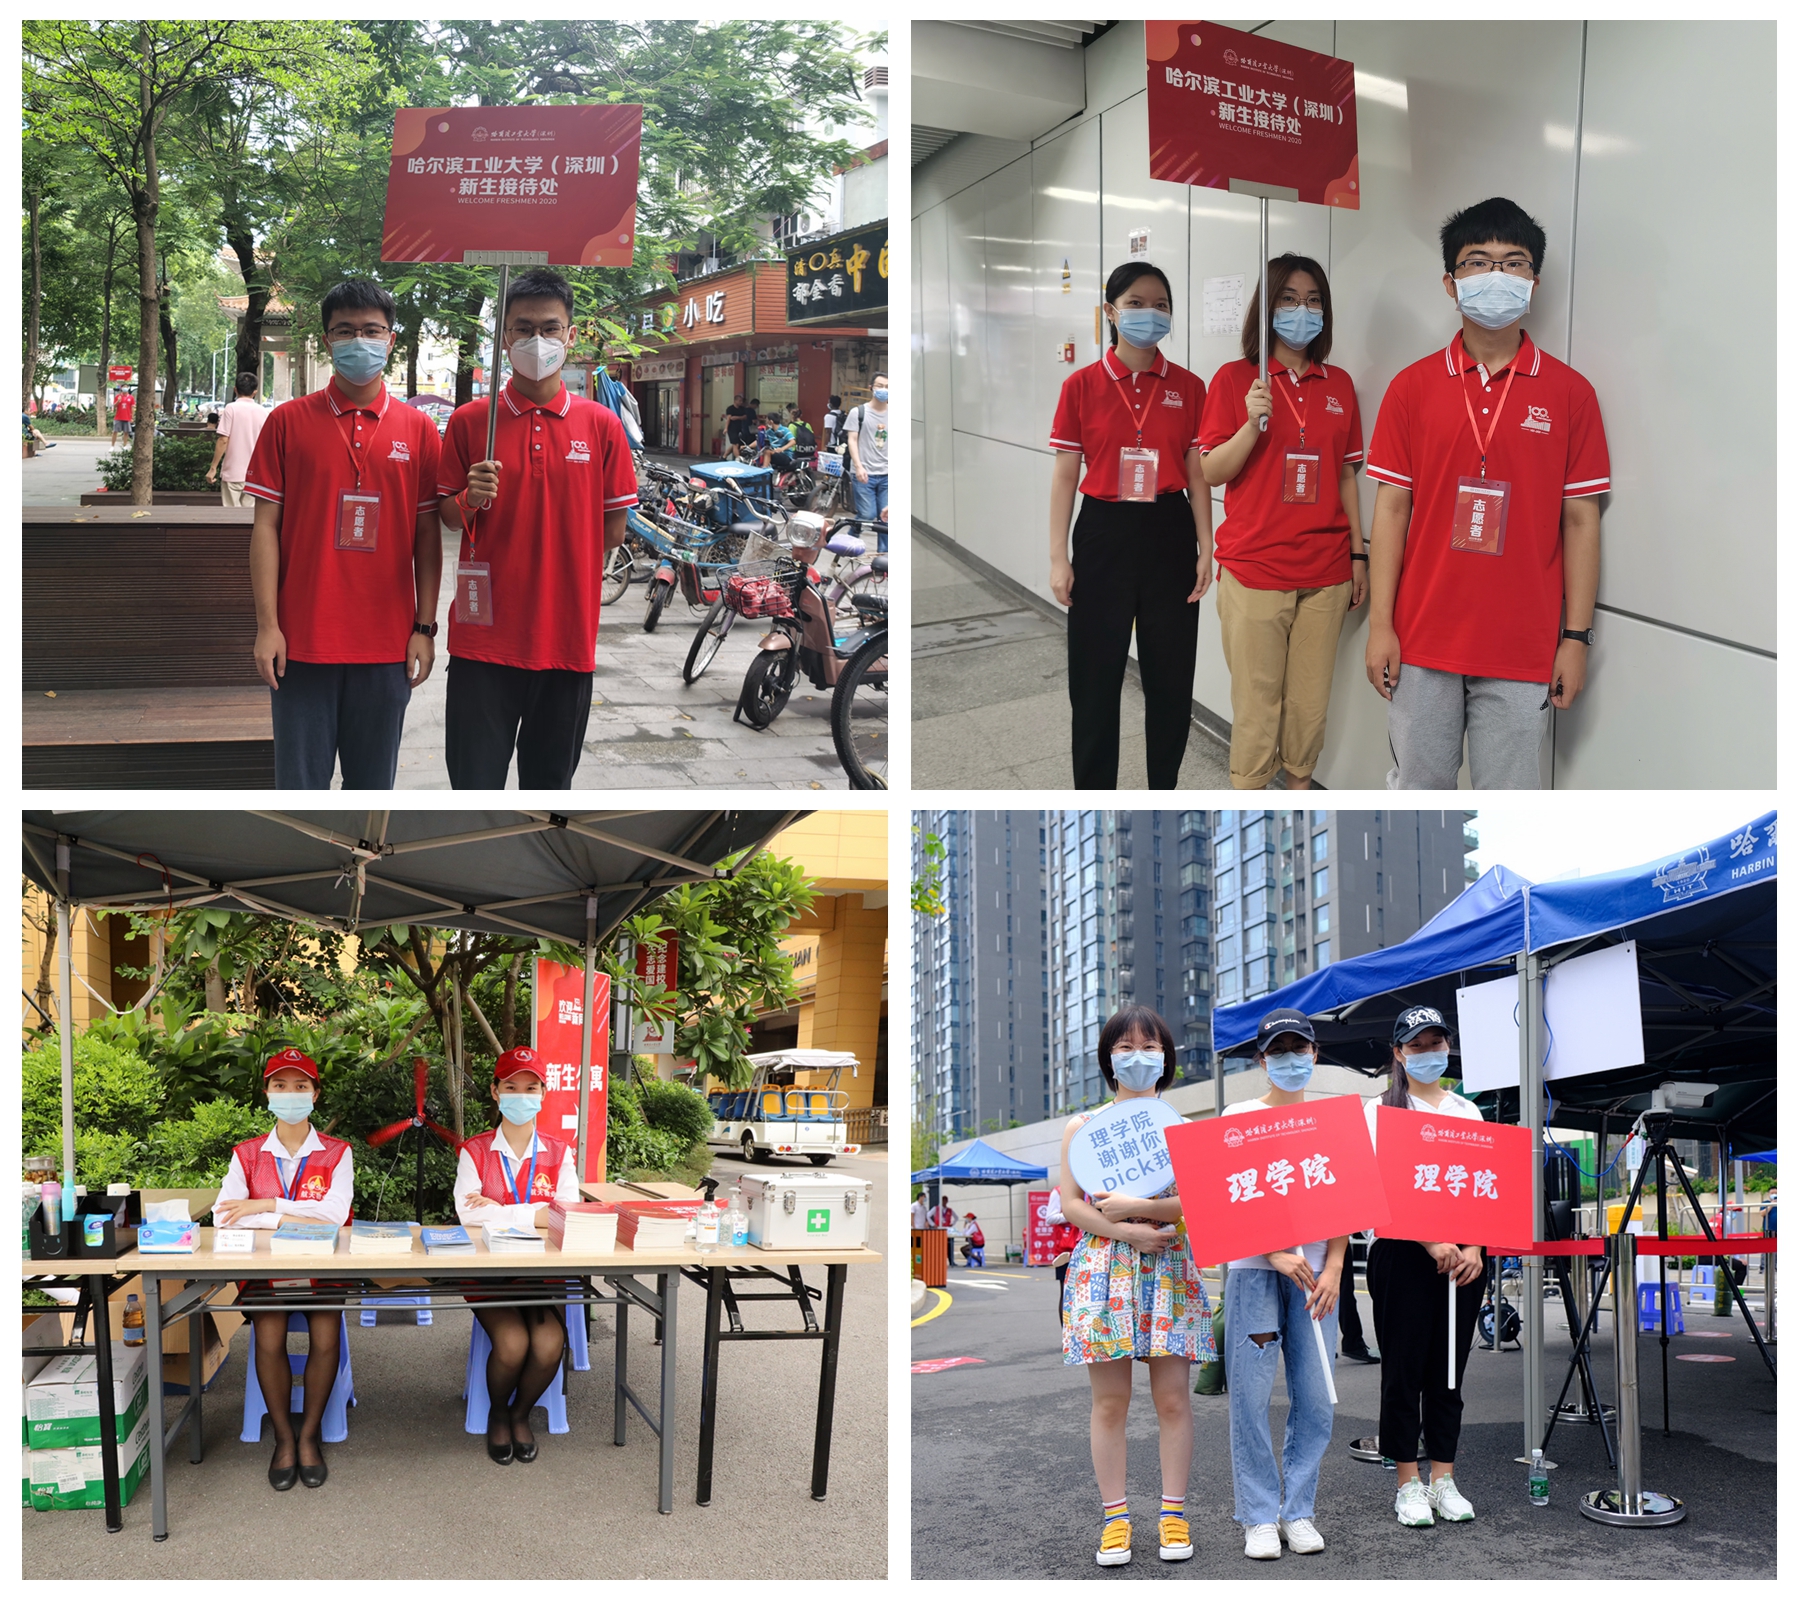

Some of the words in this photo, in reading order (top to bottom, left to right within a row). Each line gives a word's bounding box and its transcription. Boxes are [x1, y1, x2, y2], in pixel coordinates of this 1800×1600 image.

[1218, 101, 1303, 137] 新生接待处
[1218, 122, 1252, 135] WELCOME
[1252, 129, 1287, 142] FRESHMEN
[1287, 136, 1303, 145] 2020
[458, 177, 559, 196] 新生接待处
[539, 197, 558, 205] 2020
[792, 273, 845, 306] 郁金香
[682, 290, 726, 329] 小吃
[1134, 463, 1145, 493] 志愿者
[1295, 463, 1307, 493] 志愿者
[353, 505, 365, 537] 志愿者
[1469, 498, 1486, 538] 志愿者
[468, 579, 479, 613] 志愿者
[1731, 855, 1775, 880] HARBIN
[1673, 883, 1694, 894] HIT
[1264, 1016, 1300, 1030] Champion
[1088, 1110, 1154, 1149] 理学院
[1097, 1130, 1161, 1169] 谢谢你
[1225, 1153, 1337, 1203] 理学院
[1413, 1164, 1499, 1200] 理学院
